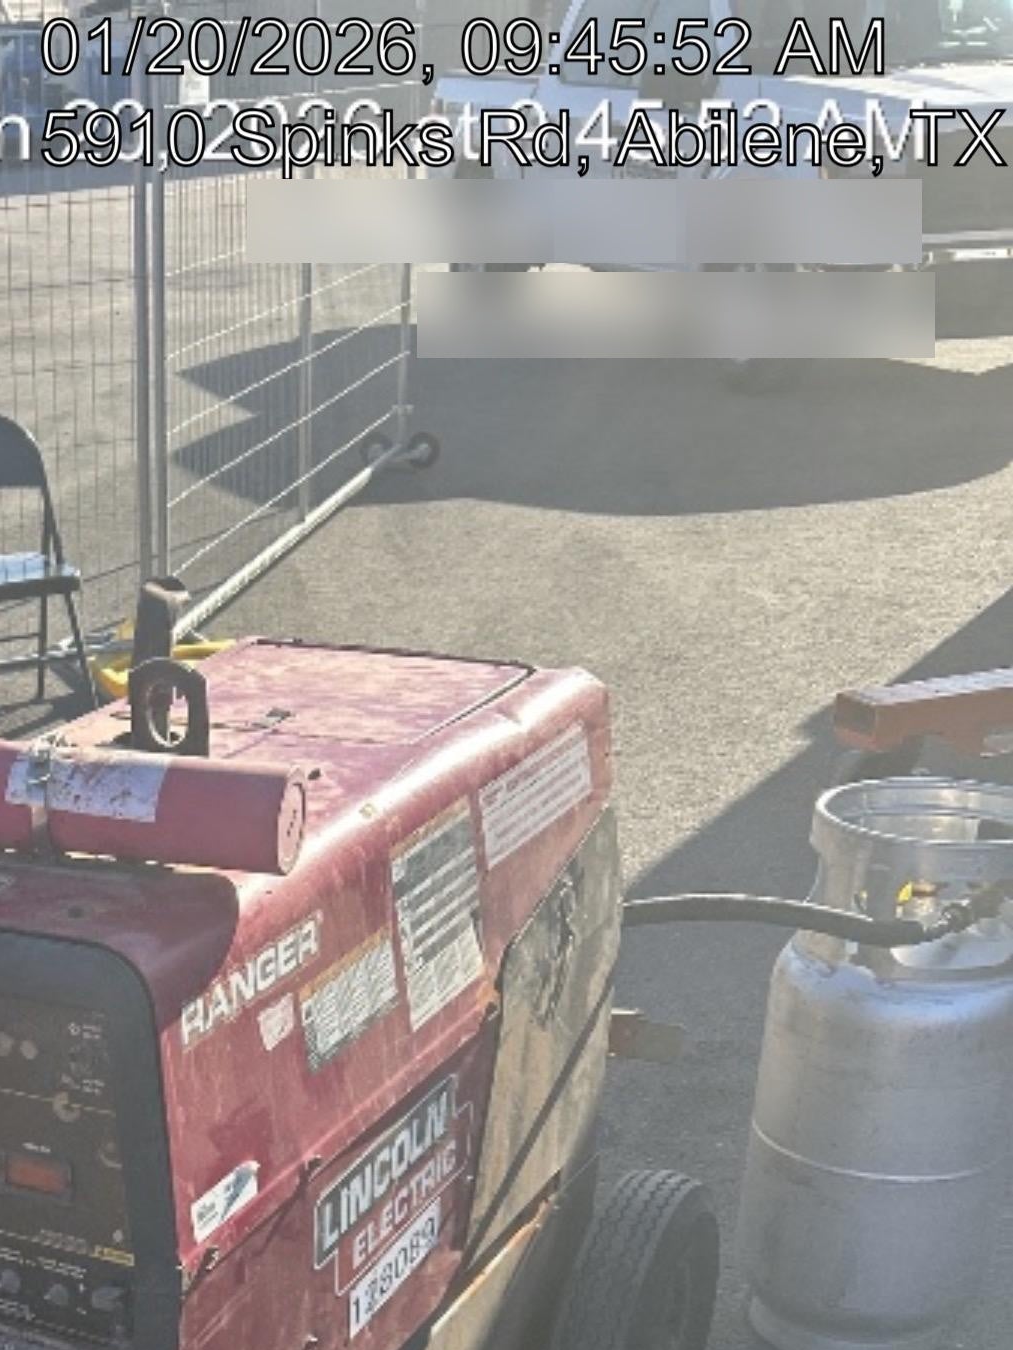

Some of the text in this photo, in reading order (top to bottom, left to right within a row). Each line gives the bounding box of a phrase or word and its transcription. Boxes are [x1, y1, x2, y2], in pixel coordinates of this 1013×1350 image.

[181, 918, 320, 1046] RANGER
[322, 1091, 448, 1252] LINCOLN
[352, 1139, 457, 1270] ELECTRIC
